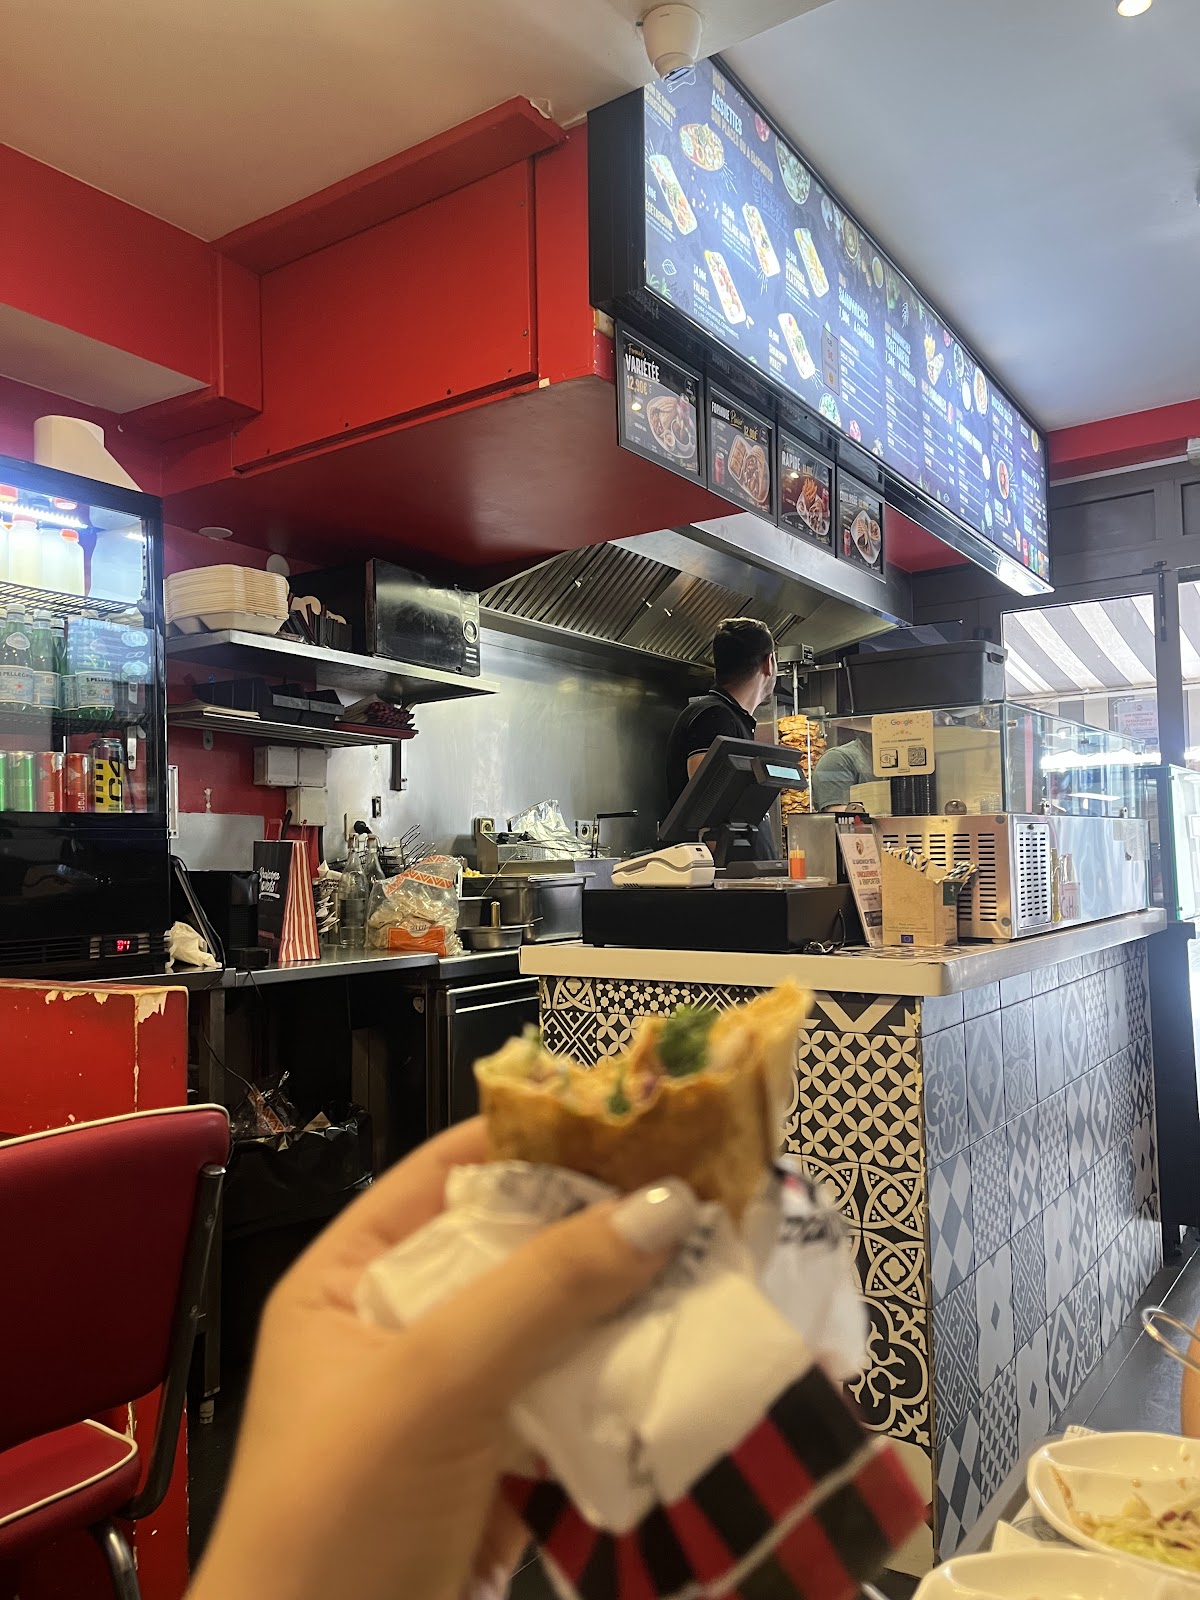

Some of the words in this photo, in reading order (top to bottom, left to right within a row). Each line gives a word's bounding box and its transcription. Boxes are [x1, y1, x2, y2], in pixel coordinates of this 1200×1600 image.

[711, 90, 742, 135] ASSIETTES
[625, 353, 660, 382] VARIÉTÉE
[627, 375, 648, 396] 12,90€
[781, 450, 801, 472] RAPIDE
[890, 719, 913, 727] Google
